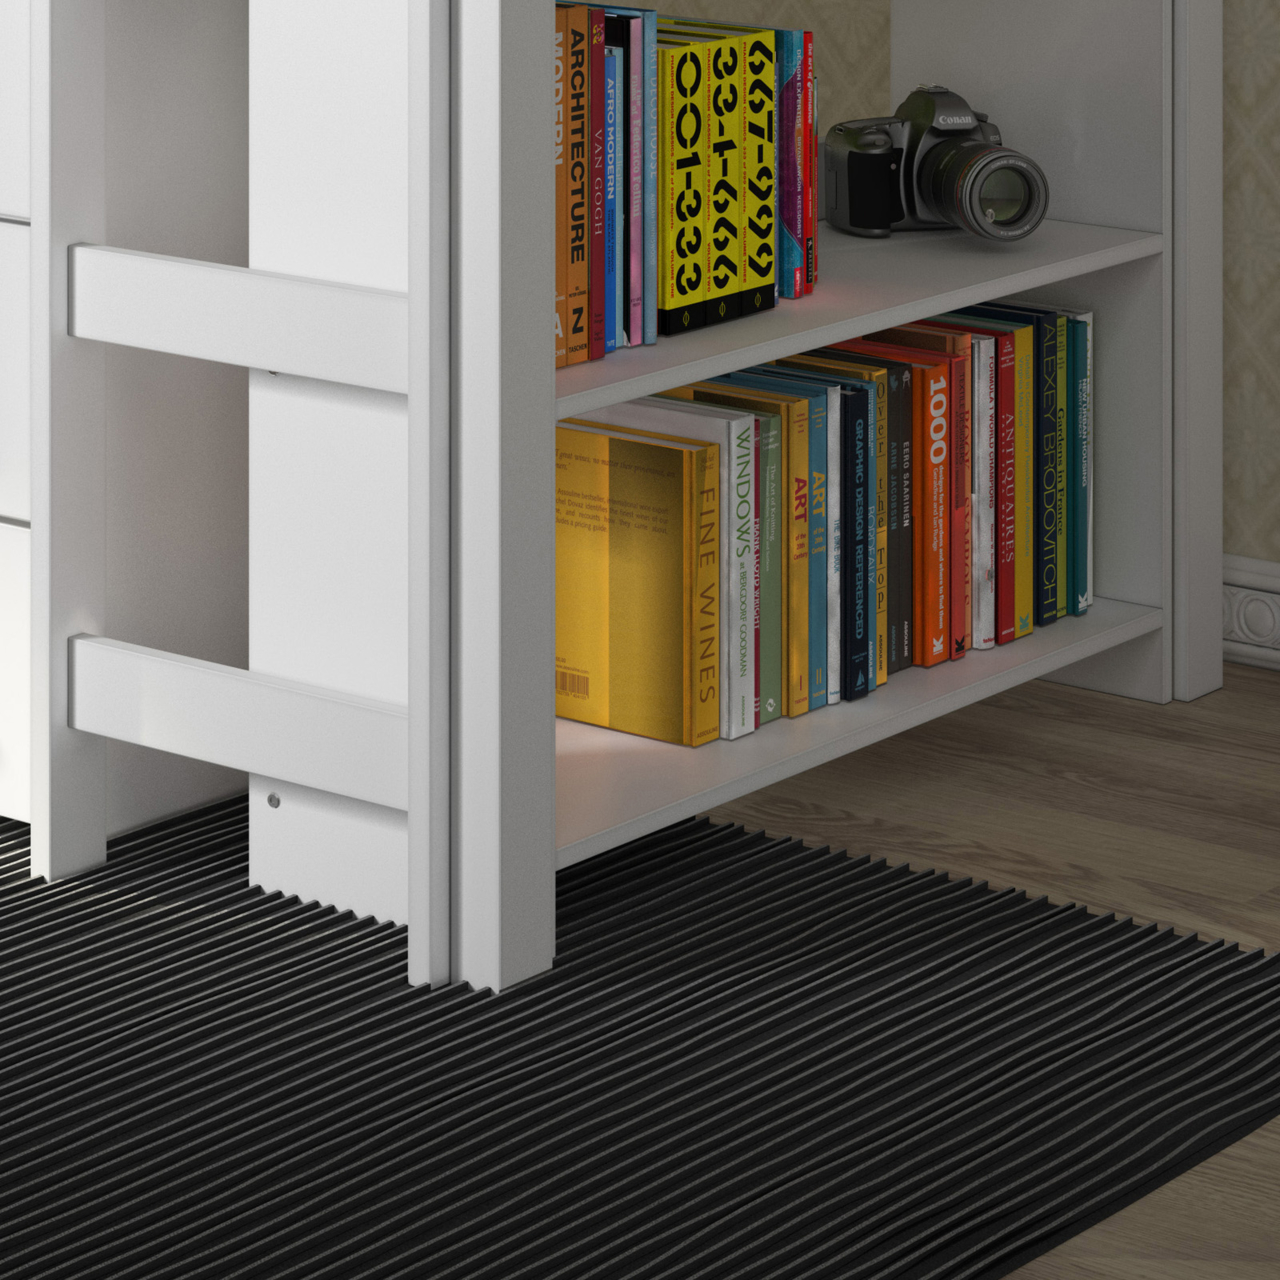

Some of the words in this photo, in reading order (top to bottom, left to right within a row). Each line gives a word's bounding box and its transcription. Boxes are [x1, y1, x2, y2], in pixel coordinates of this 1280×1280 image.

[606, 77, 615, 124] AFRO
[938, 114, 972, 125] Conan
[570, 28, 585, 265] ARCHITECTURE
[594, 127, 603, 168] VAN
[606, 126, 615, 201] MODERN
[632, 119, 642, 176] Federico
[675, 51, 702, 296] 001-333
[713, 46, 738, 290] 334-666
[748, 40, 773, 278] 667-999
[594, 176, 603, 236] GOGH
[632, 179, 642, 218] Fellini
[572, 306, 584, 335] Z
[1043, 323, 1056, 423] ALEXEY
[929, 375, 947, 465] 1000
[1057, 407, 1065, 467] Gardens
[769, 464, 777, 480] The
[855, 418, 864, 484] GRAPHIC
[890, 441, 898, 470] ARNE
[1057, 469, 1065, 485] in
[735, 426, 752, 558] WINDOWS
[769, 481, 777, 495] Art
[769, 496, 777, 507] of
[795, 477, 808, 524] ART
[812, 470, 826, 517] ART
[855, 486, 864, 541] DESIGN
[890, 474, 898, 531] JACOBSEN
[1004, 412, 1015, 563] ANTIQUAIRES
[1057, 486, 1065, 537] France
[699, 485, 716, 569] FINE
[769, 506, 777, 542] Knitting
[1043, 431, 1056, 605] BRODOVITCH
[739, 561, 746, 570] at
[855, 543, 864, 640] REFERENCED
[739, 570, 748, 622] BERGDORF
[699, 582, 716, 704] WINES
[739, 623, 748, 678] GOODMAN
